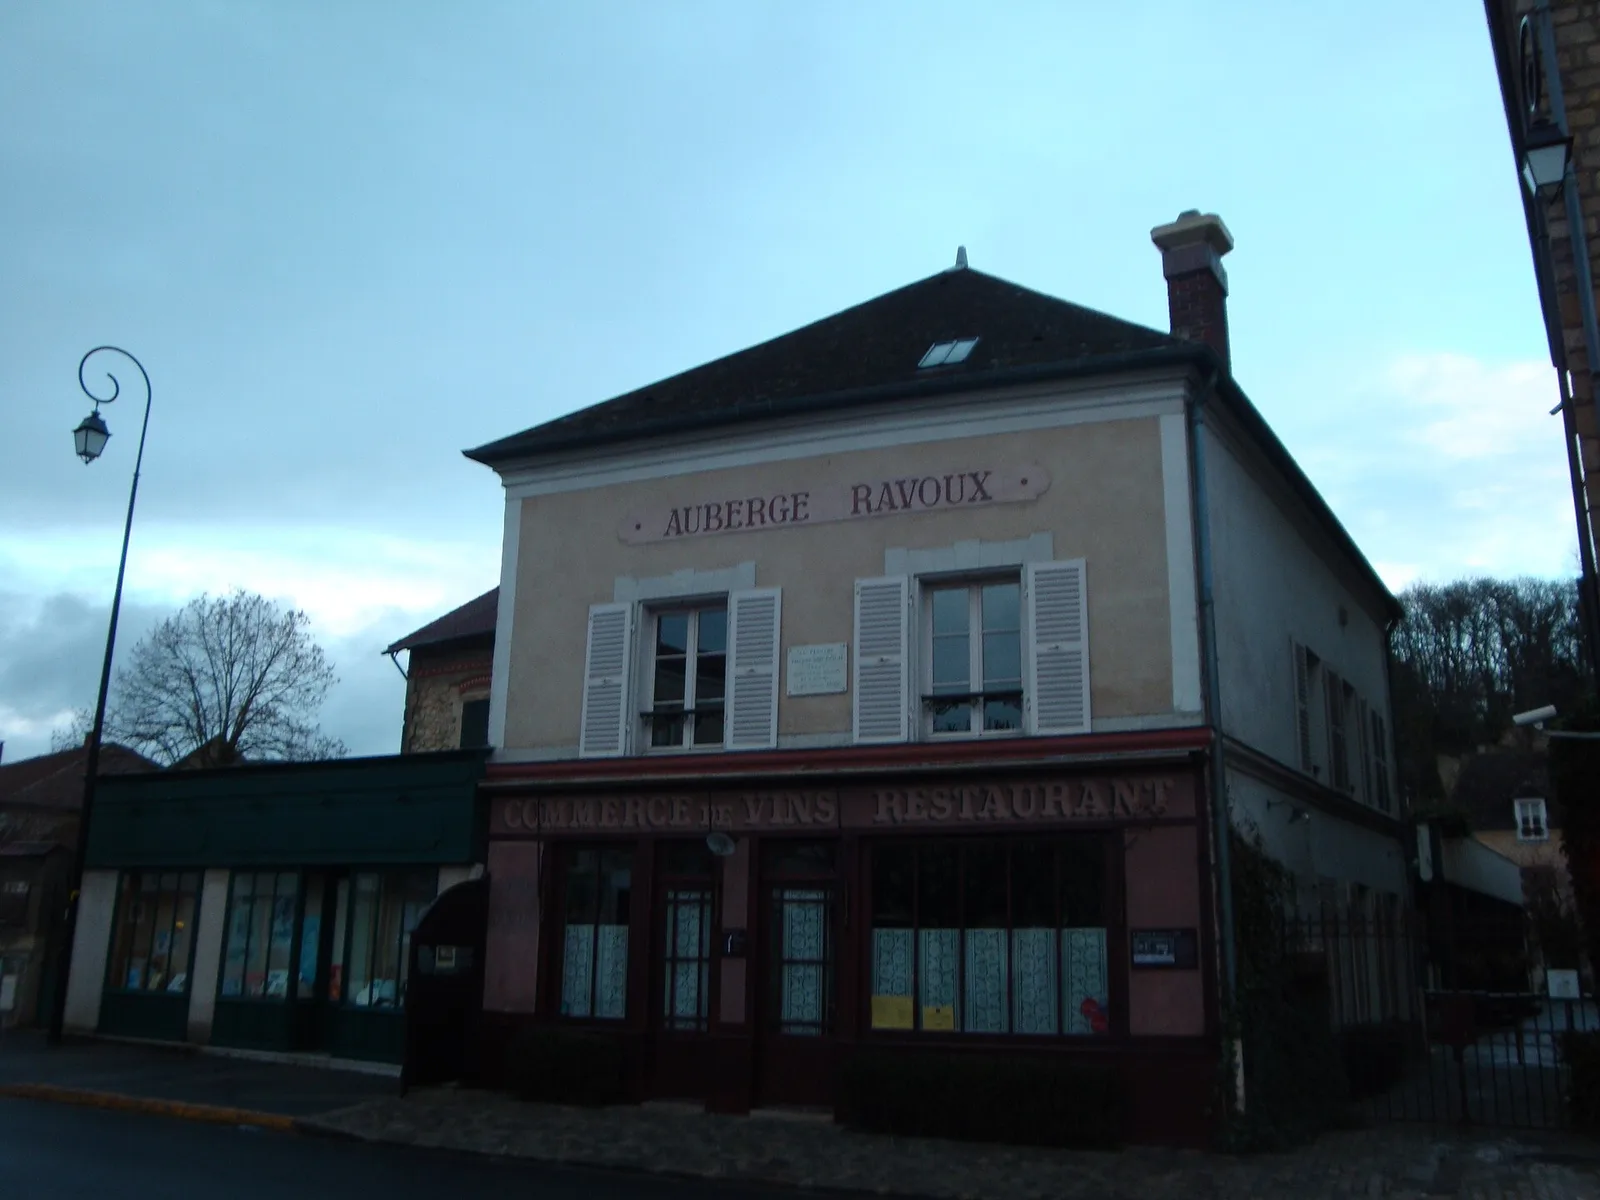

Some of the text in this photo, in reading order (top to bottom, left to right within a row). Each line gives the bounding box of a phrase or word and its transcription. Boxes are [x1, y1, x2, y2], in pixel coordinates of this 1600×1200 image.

[664, 470, 993, 537] AUBERGE RAVOUX
[503, 778, 1176, 829] COMMERCE DE VINS RESTAURANT
